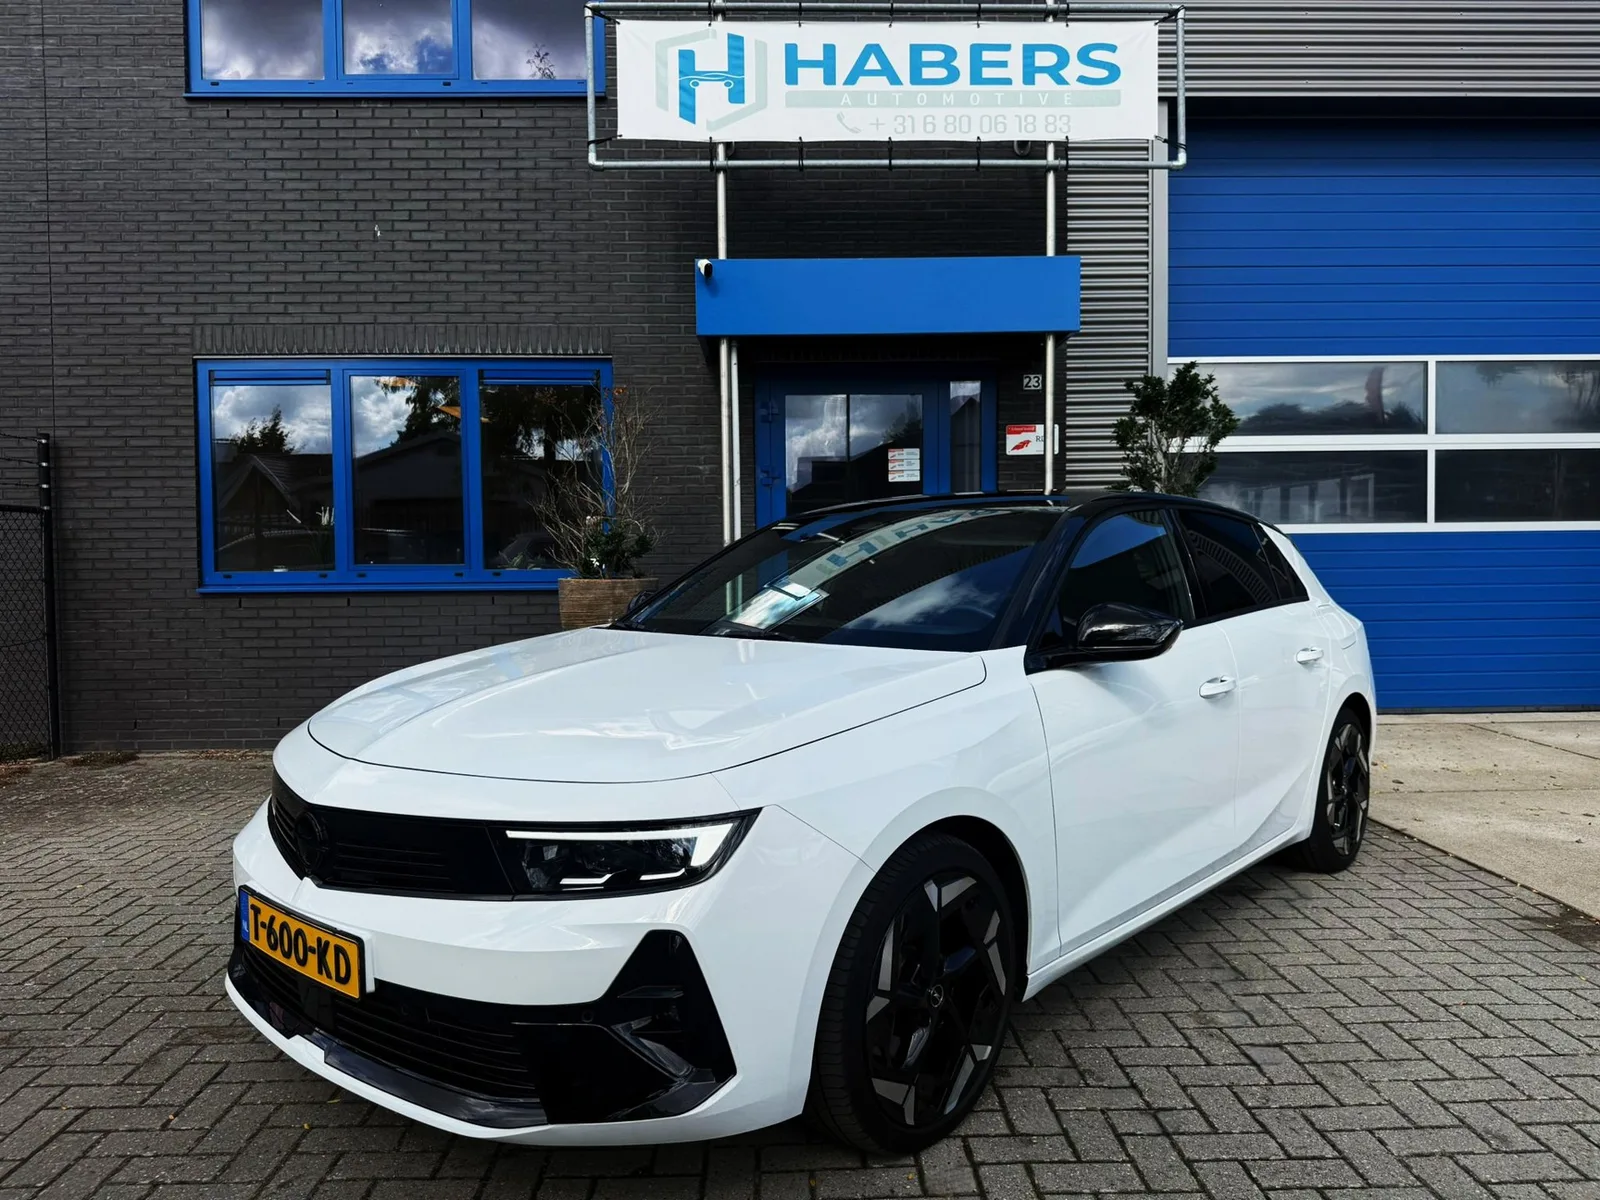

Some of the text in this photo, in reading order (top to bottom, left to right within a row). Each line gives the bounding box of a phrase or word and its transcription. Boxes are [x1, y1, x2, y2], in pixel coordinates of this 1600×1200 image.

[784, 43, 1121, 86] HABERS
[840, 90, 1072, 107] AUTOMOTIVE
[893, 114, 916, 135] 31
[923, 114, 937, 135] 6
[943, 114, 972, 135] 80
[979, 114, 1007, 134] 06
[1014, 114, 1037, 134] 18
[1044, 113, 1071, 134] 83
[1024, 375, 1041, 388] 23
[250, 903, 352, 985] T-600-KD
